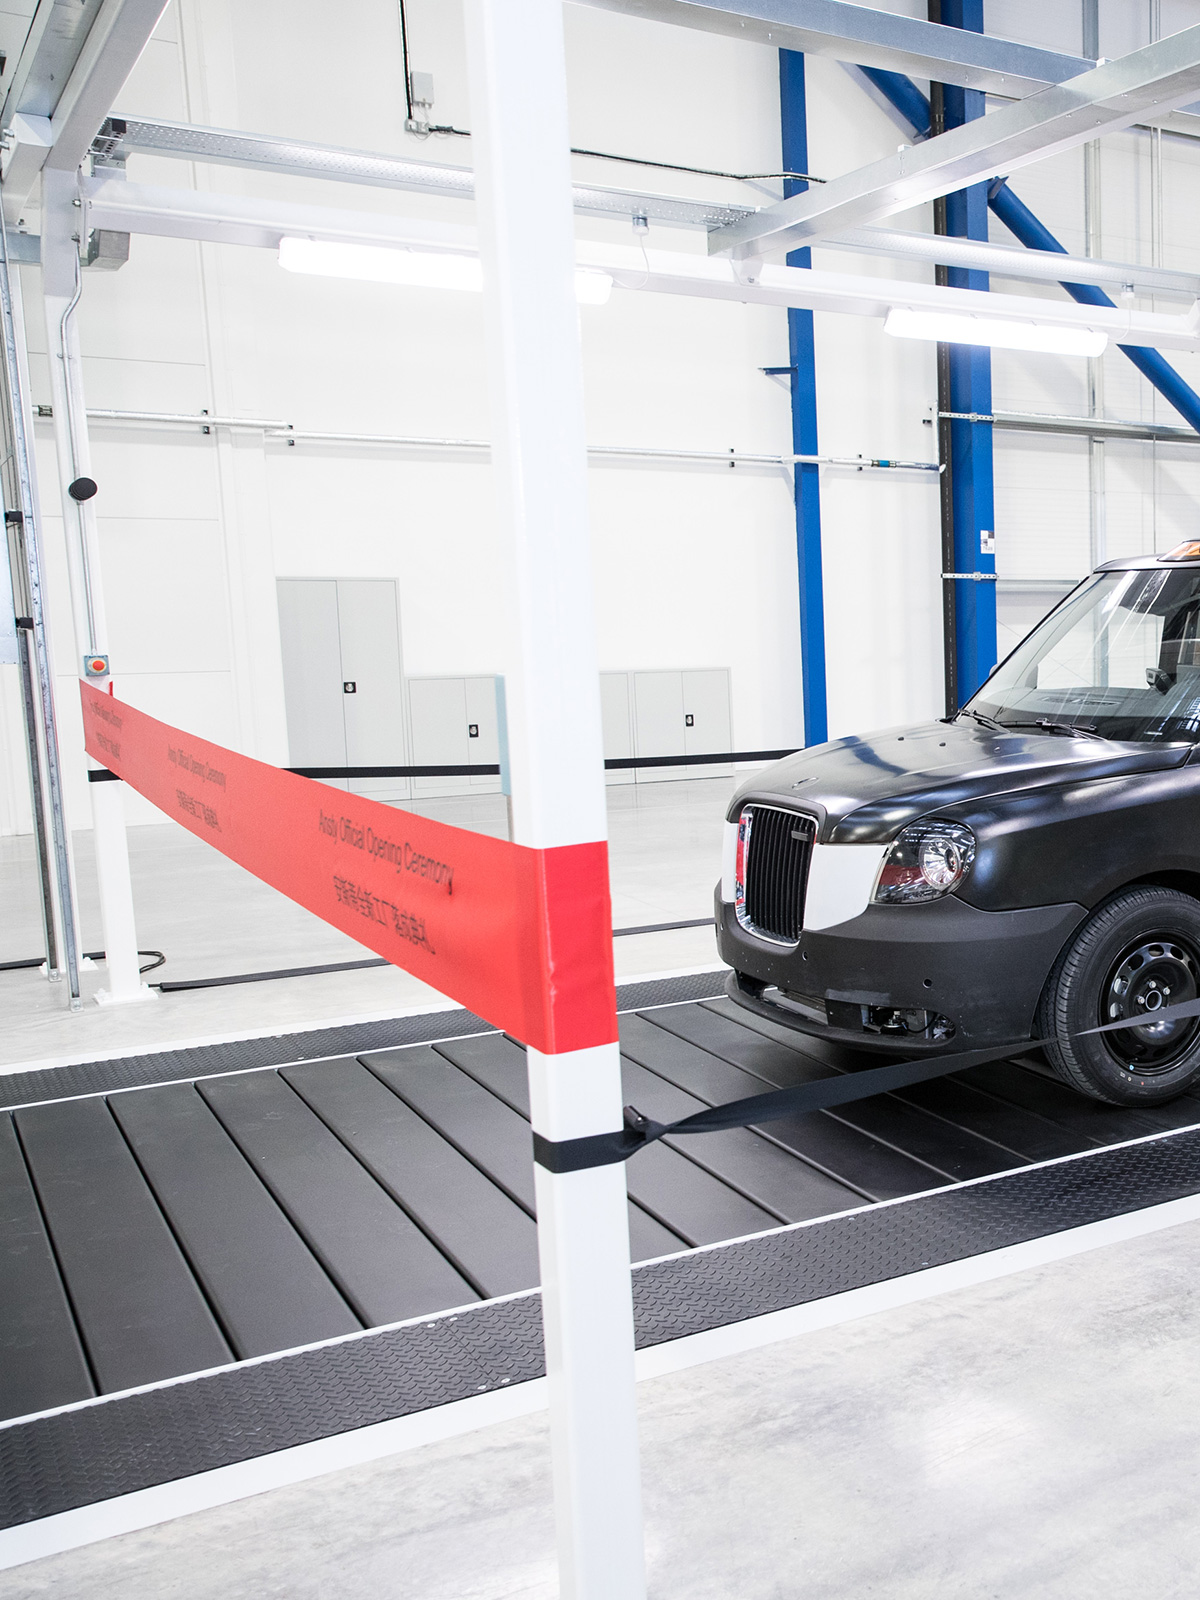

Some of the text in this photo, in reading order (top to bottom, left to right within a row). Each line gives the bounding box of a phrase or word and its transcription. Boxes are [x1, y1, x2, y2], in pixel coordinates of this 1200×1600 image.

[319, 809, 454, 896] Ansty Official Opening Ceremony
